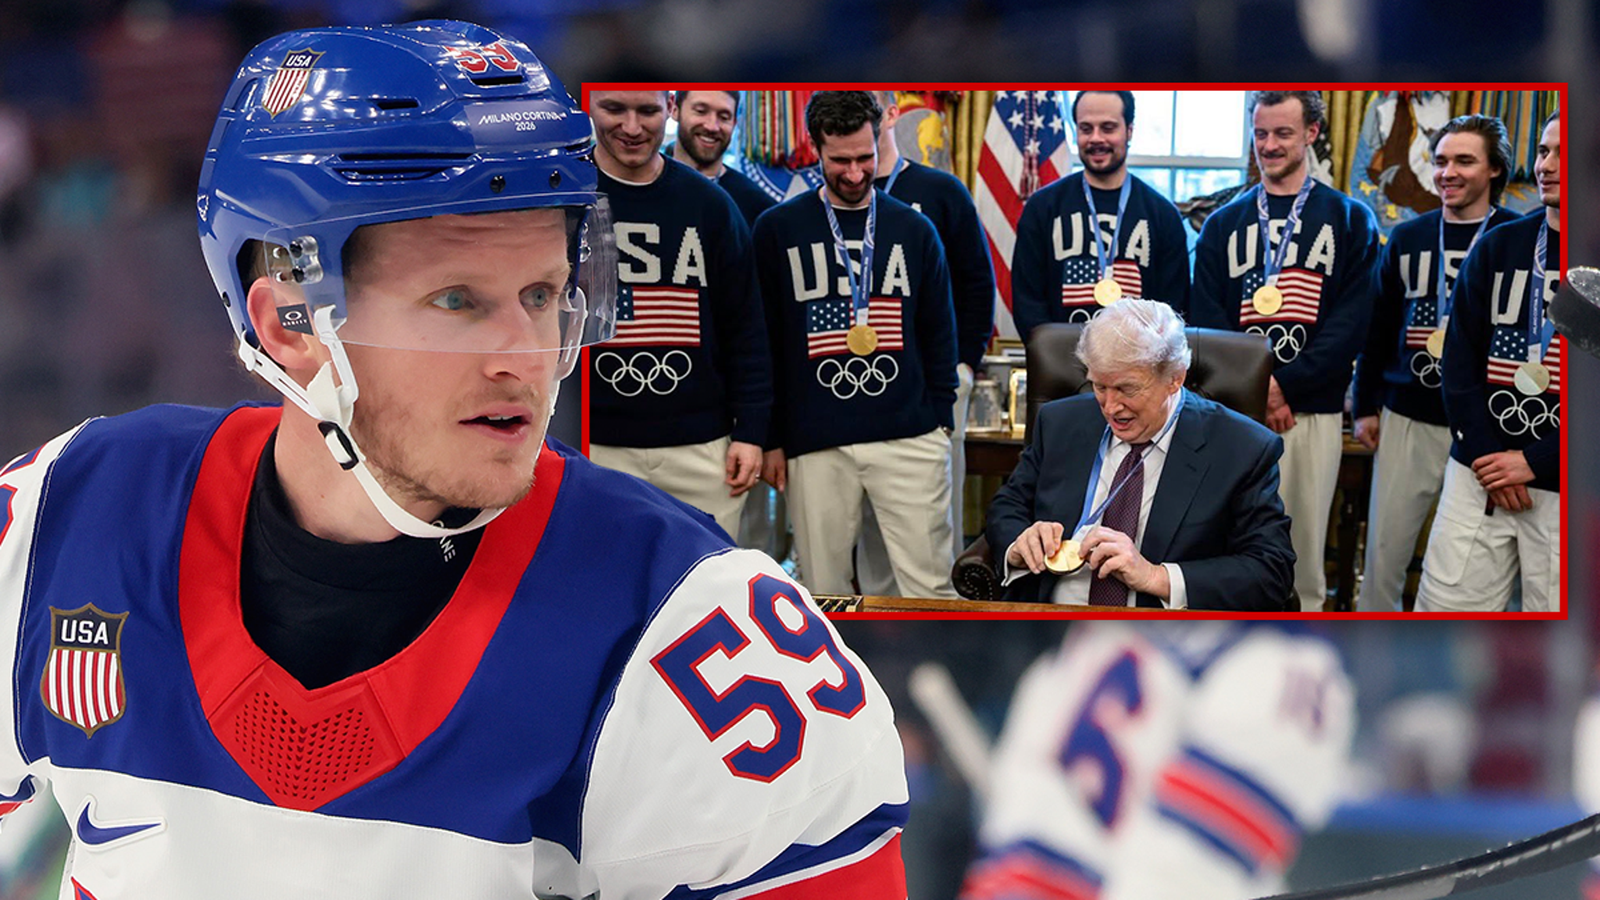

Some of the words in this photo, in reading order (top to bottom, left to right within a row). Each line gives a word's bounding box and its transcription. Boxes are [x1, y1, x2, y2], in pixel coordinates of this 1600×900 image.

[285, 54, 313, 67] USA
[478, 112, 521, 125] MILANO
[522, 111, 567, 121] CORTINA
[515, 121, 536, 131] 2026
[613, 221, 708, 287] SA
[1052, 211, 1150, 268] USA
[1227, 218, 1336, 279] USA
[787, 240, 911, 302] USA
[1399, 250, 1468, 299] US
[61, 619, 109, 645] USA
[650, 572, 866, 783] 59
